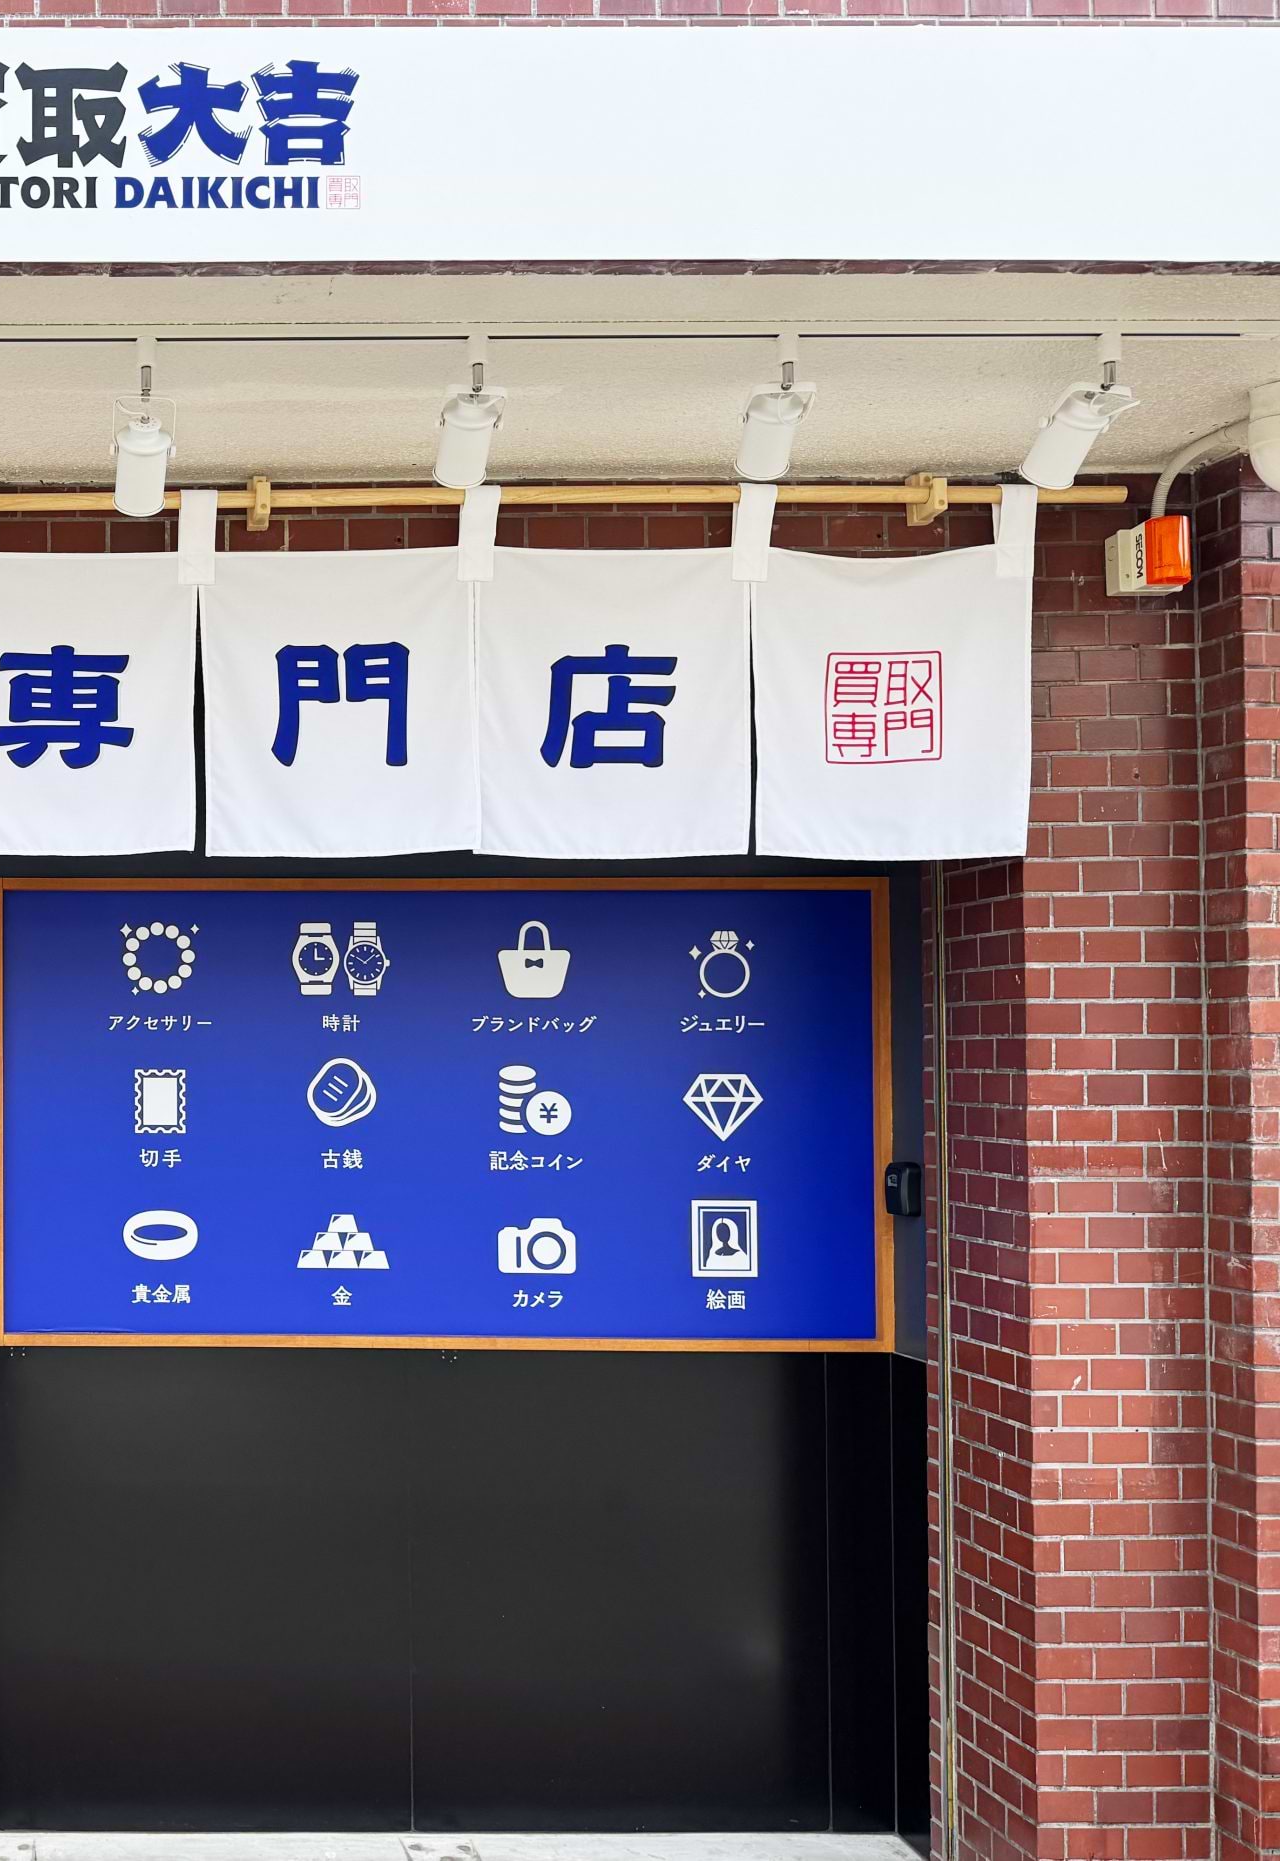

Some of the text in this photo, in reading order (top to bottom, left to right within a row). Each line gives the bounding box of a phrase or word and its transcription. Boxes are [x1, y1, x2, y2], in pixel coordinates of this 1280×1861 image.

[115, 177, 319, 209] DAIKICHI
[1135, 533, 1144, 579] SECOM
[109, 1015, 211, 1031] アクセサリー
[323, 1014, 360, 1032] 時計
[472, 1016, 597, 1032] ブランドバッグ
[681, 1015, 764, 1033] ジュエリー
[140, 1149, 181, 1168] 切手
[321, 1149, 363, 1169] 古銭
[489, 1151, 582, 1170] 記念コイン
[697, 1154, 750, 1172] ダイヤ
[132, 1284, 190, 1303] 貴金属
[332, 1286, 352, 1305] 金
[513, 1290, 563, 1308] カメラ
[706, 1289, 745, 1309] 絵画
